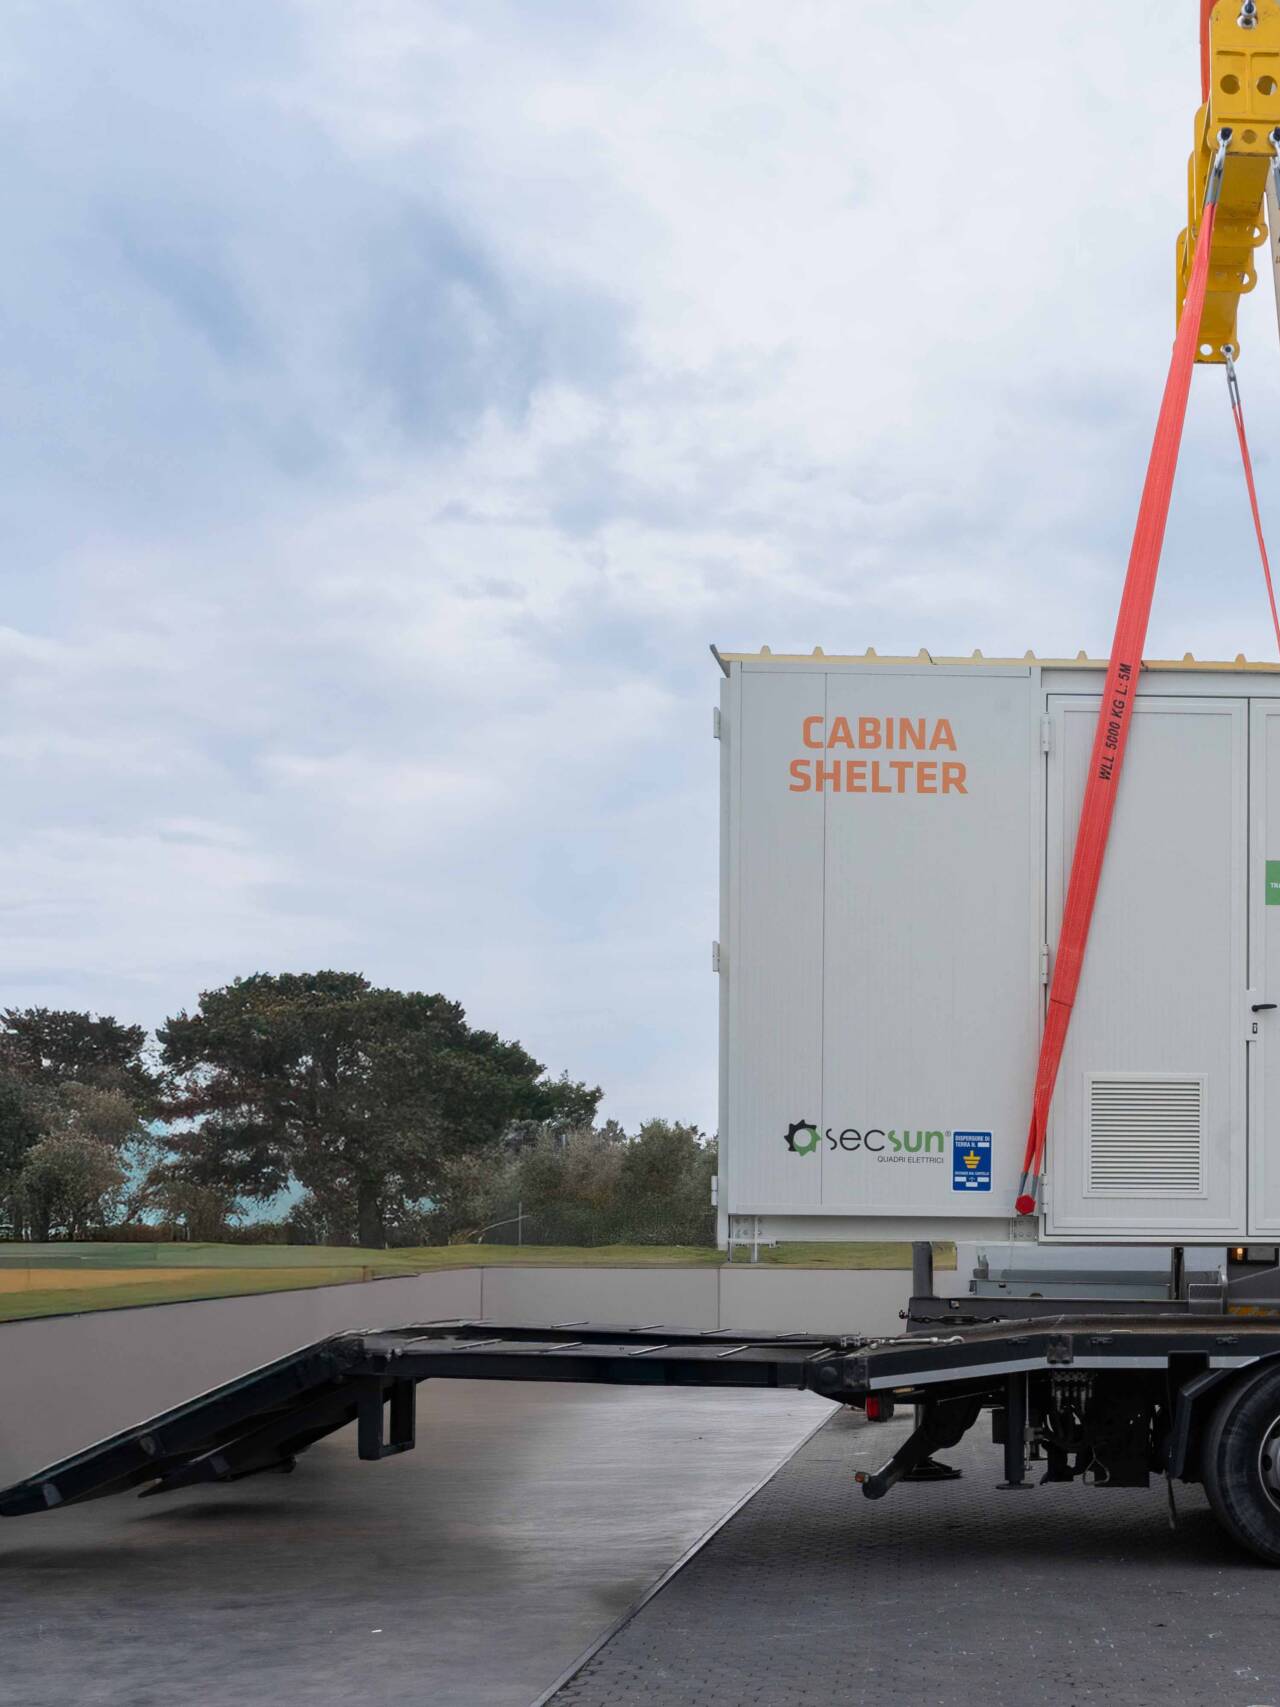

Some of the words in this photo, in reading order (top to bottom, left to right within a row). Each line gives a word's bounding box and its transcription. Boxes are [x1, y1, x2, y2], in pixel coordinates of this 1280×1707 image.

[1111, 699, 1126, 719] KG
[802, 715, 957, 751] CABINA
[1106, 721, 1121, 751] 5000
[789, 759, 968, 794] SHELTER
[1099, 755, 1115, 781] WLL
[877, 1155, 906, 1164] QUADRI
[907, 1156, 944, 1164] ELETTRICI
